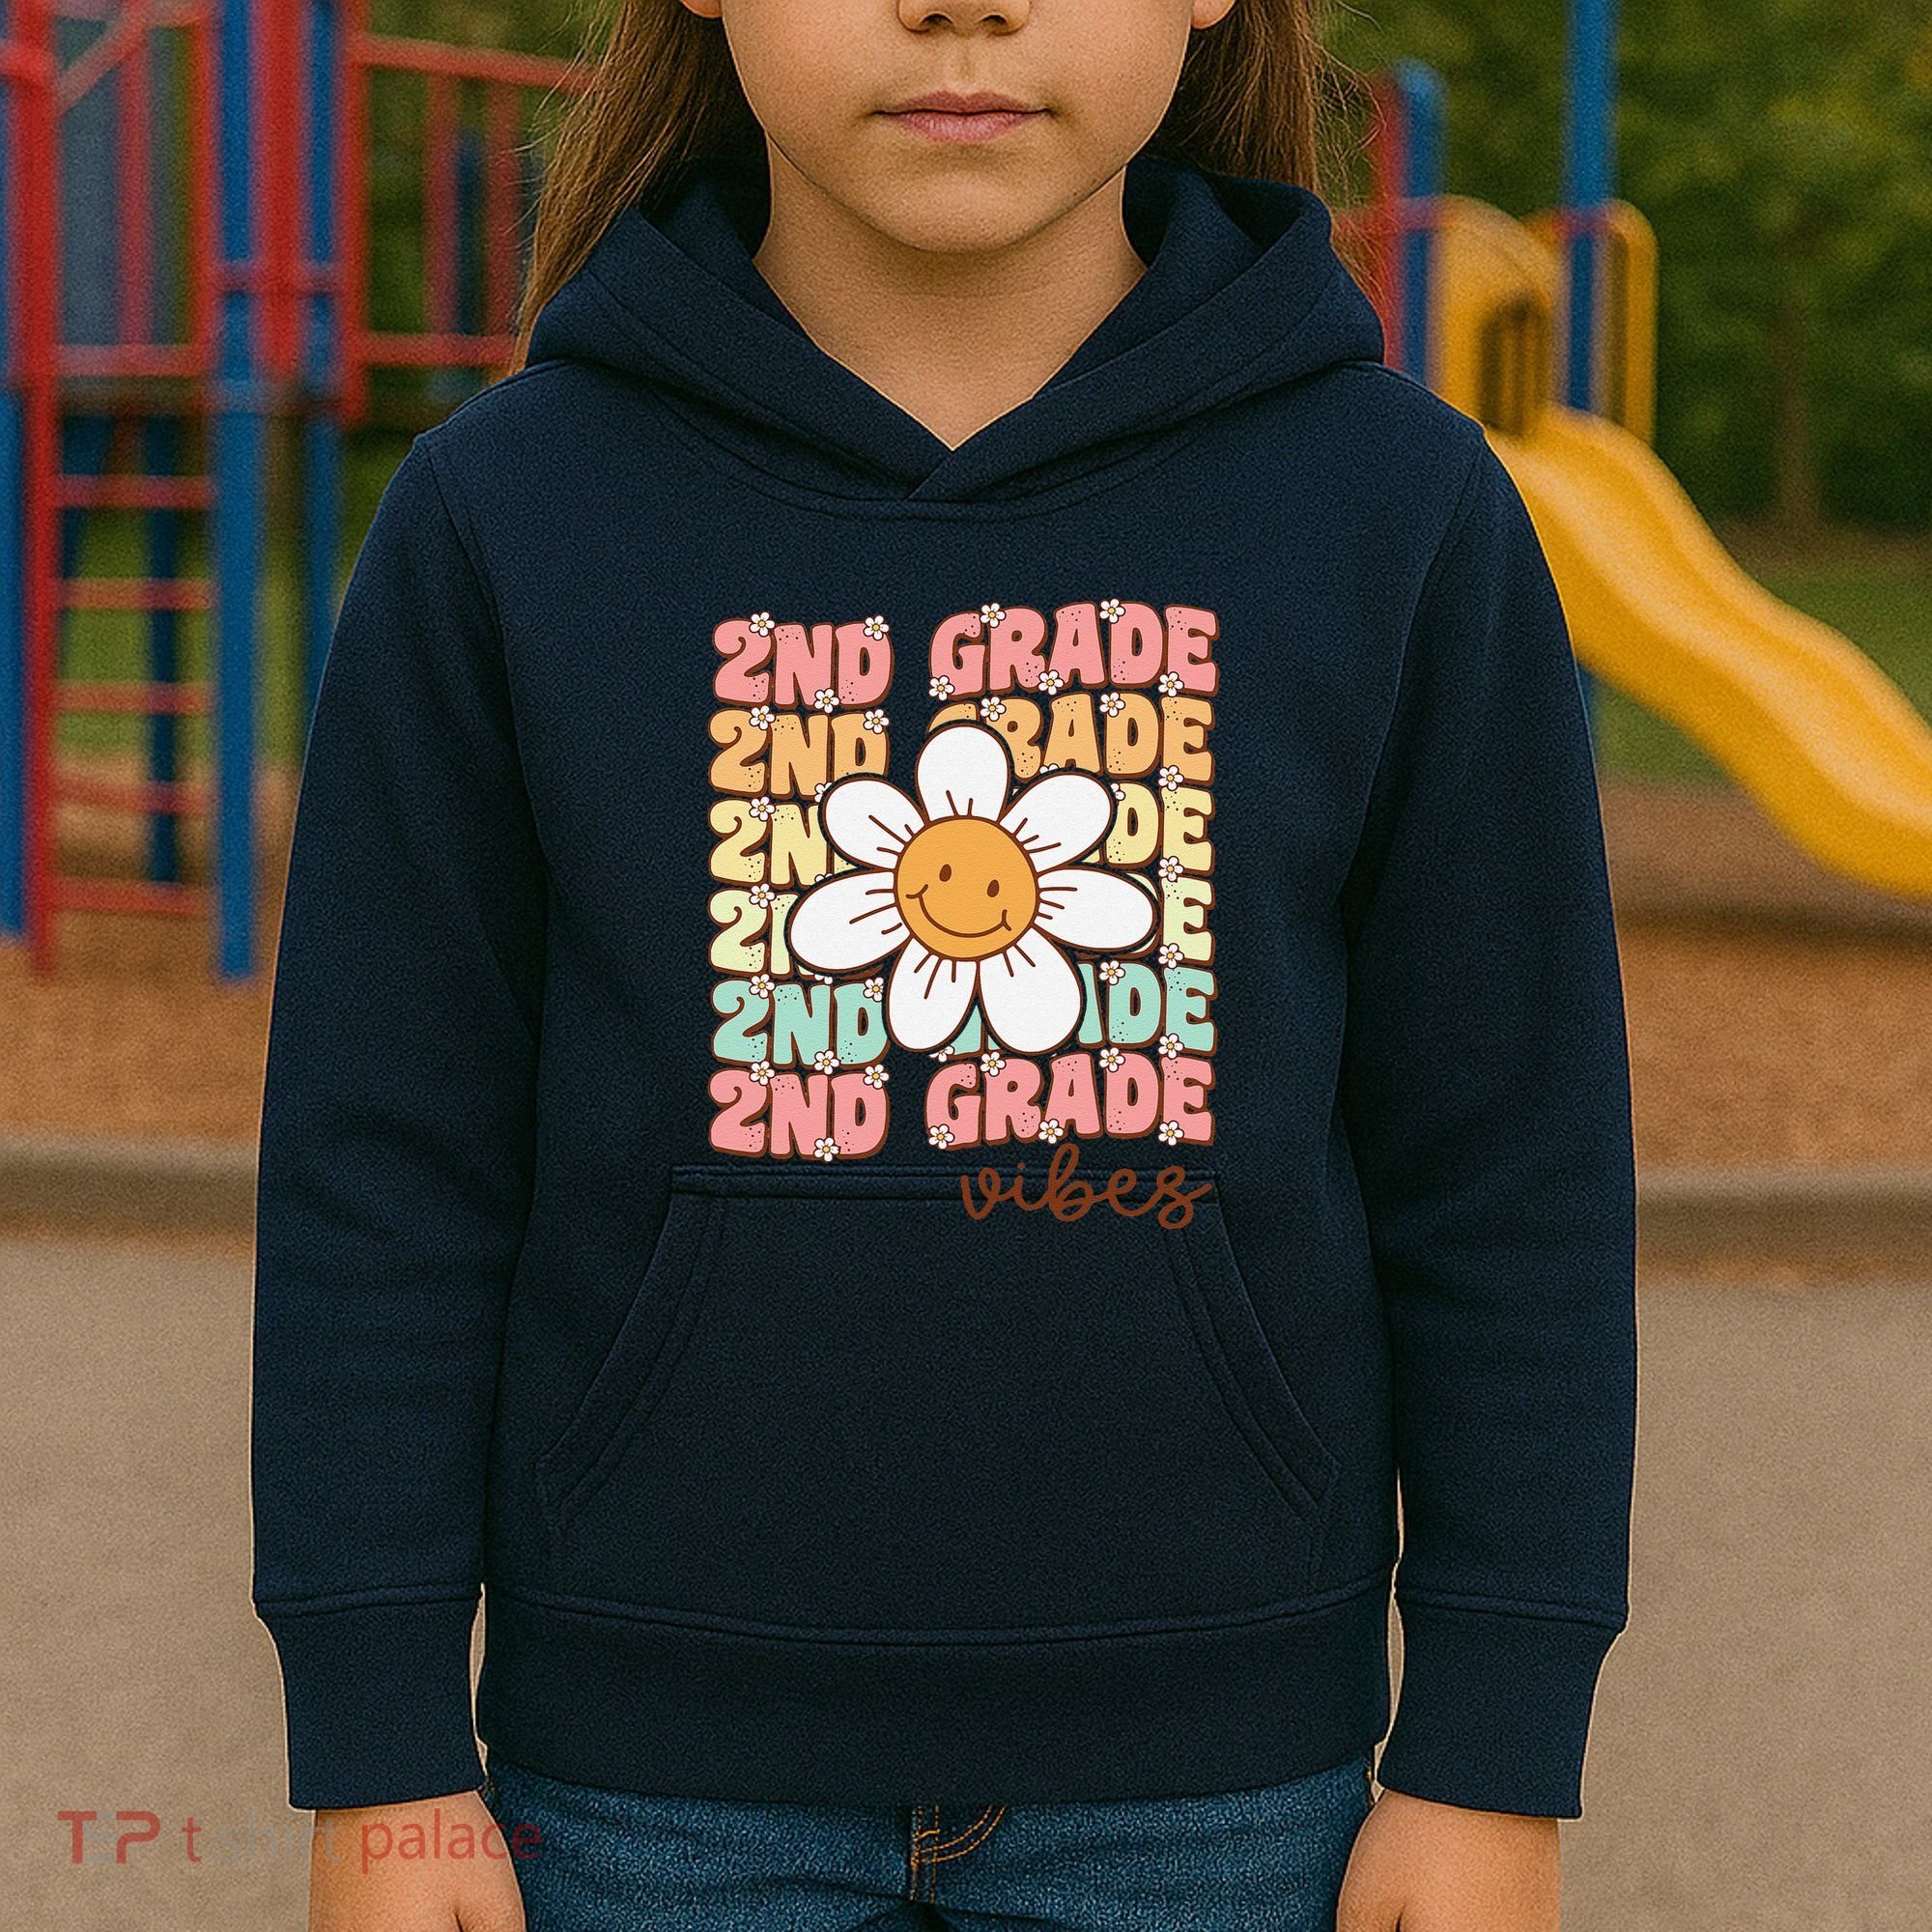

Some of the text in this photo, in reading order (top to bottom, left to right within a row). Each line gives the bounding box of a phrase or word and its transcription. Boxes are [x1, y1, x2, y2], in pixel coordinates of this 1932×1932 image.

[711, 602, 1219, 709] 2ND GRADE
[708, 695, 1215, 801] 2ND RADE
[708, 800, 859, 888] 2N
[708, 979, 891, 1068] 2ND
[708, 1050, 1215, 1161] 2ND GRADE
[960, 1144, 1215, 1230] vibes
